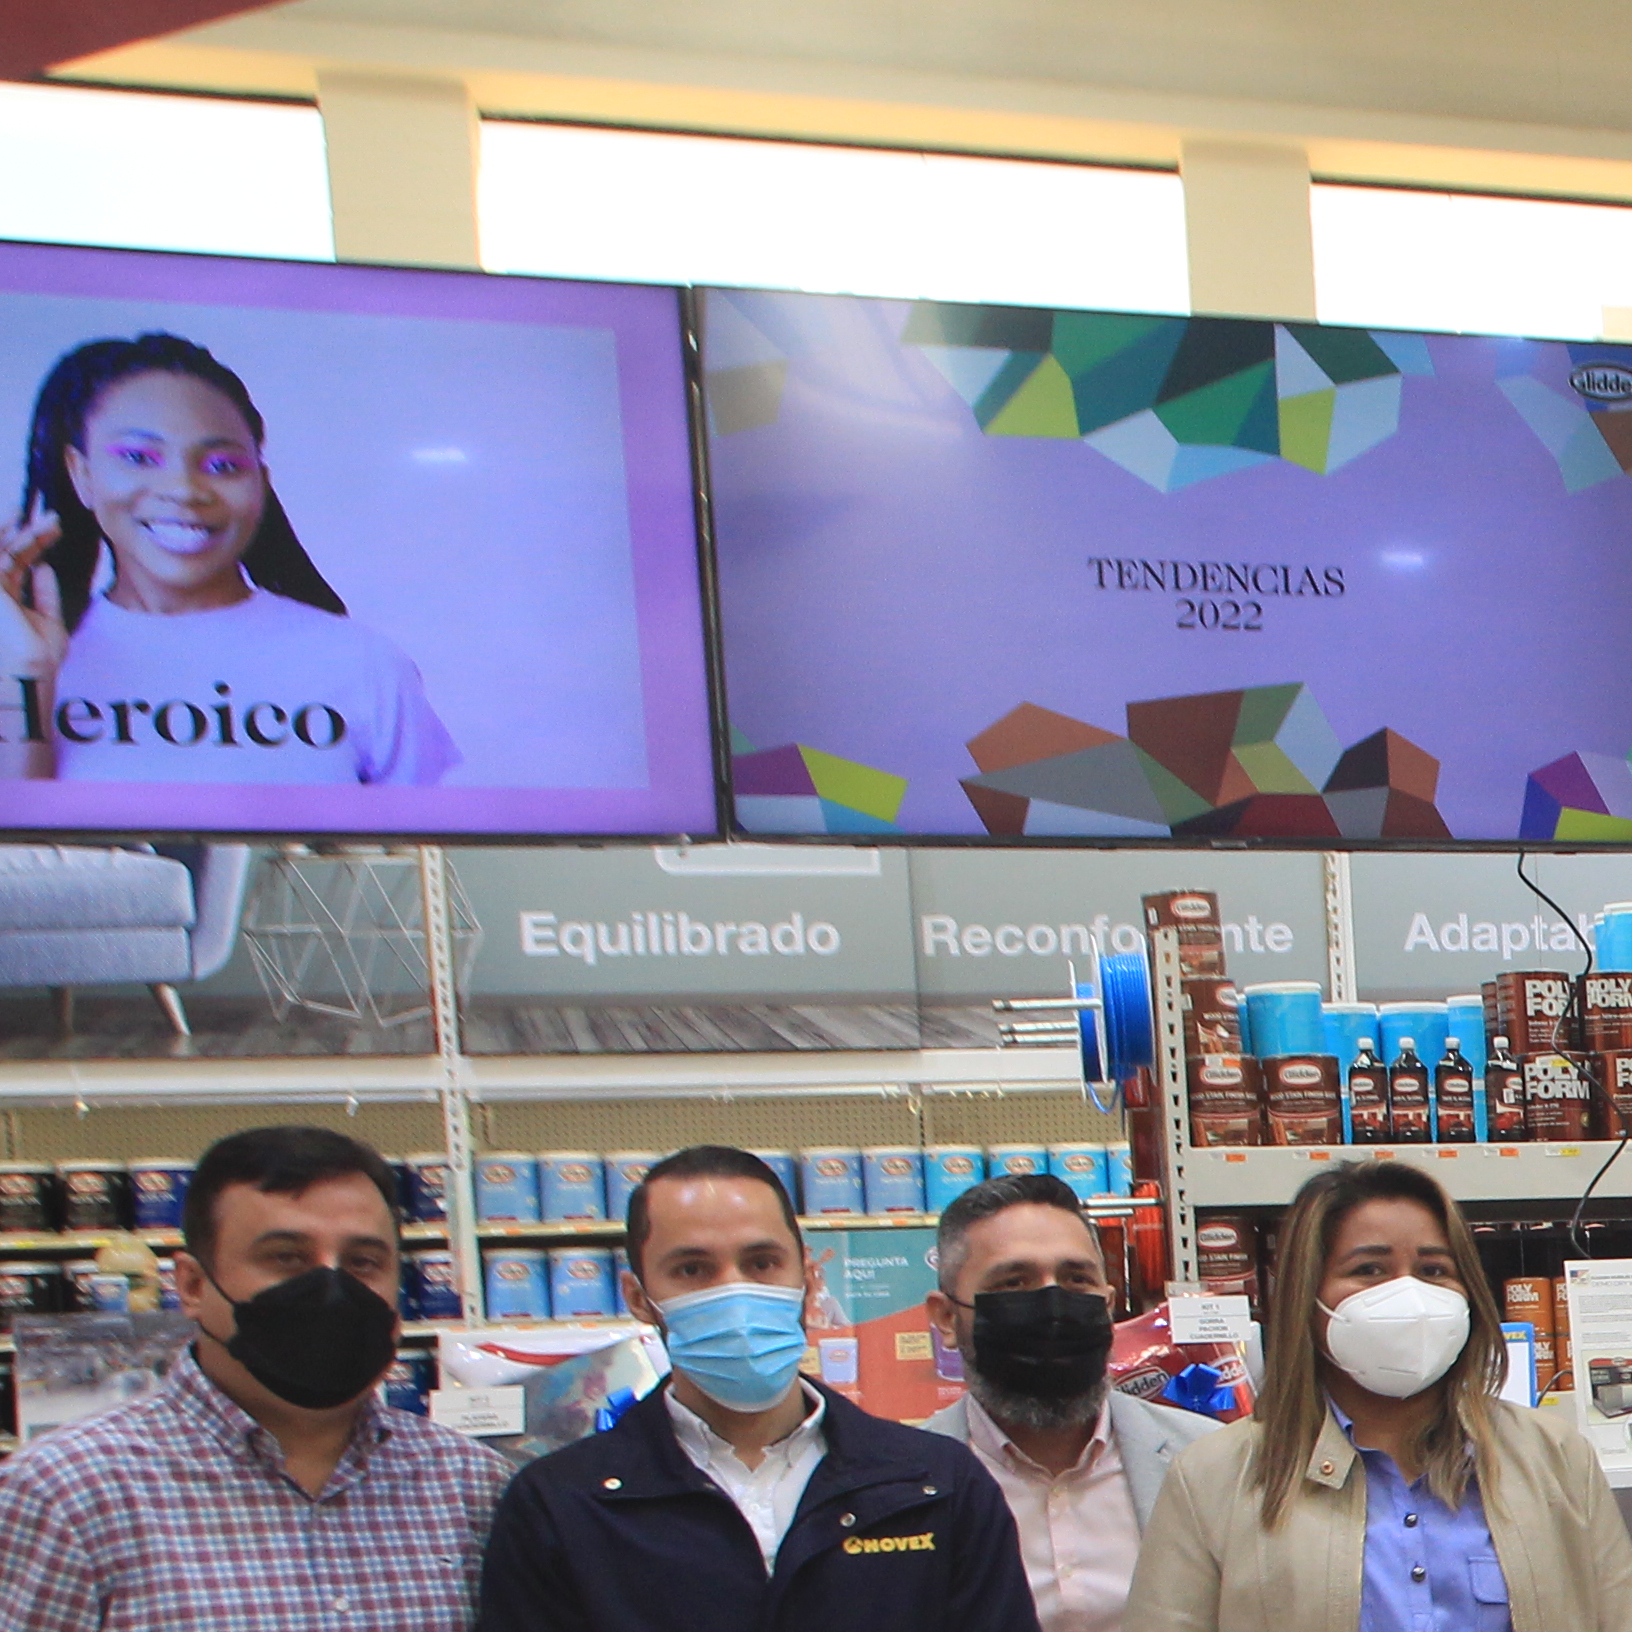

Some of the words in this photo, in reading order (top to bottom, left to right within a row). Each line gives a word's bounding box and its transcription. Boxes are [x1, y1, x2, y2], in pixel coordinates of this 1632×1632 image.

[1088, 557, 1346, 597] TENDENCIAS
[1176, 600, 1264, 632] 2022
[519, 912, 842, 964] Equilibrado
[920, 914, 1293, 957] Reconfonte
[1404, 912, 1598, 959] Adaptab
[1585, 978, 1632, 995] POLY
[1527, 1080, 1590, 1100] FORM
[844, 1257, 908, 1268] PREGUNTA
[1507, 1283, 1532, 1294] POLY
[1507, 1292, 1539, 1303] FORM
[864, 1532, 935, 1554] NOVEX
